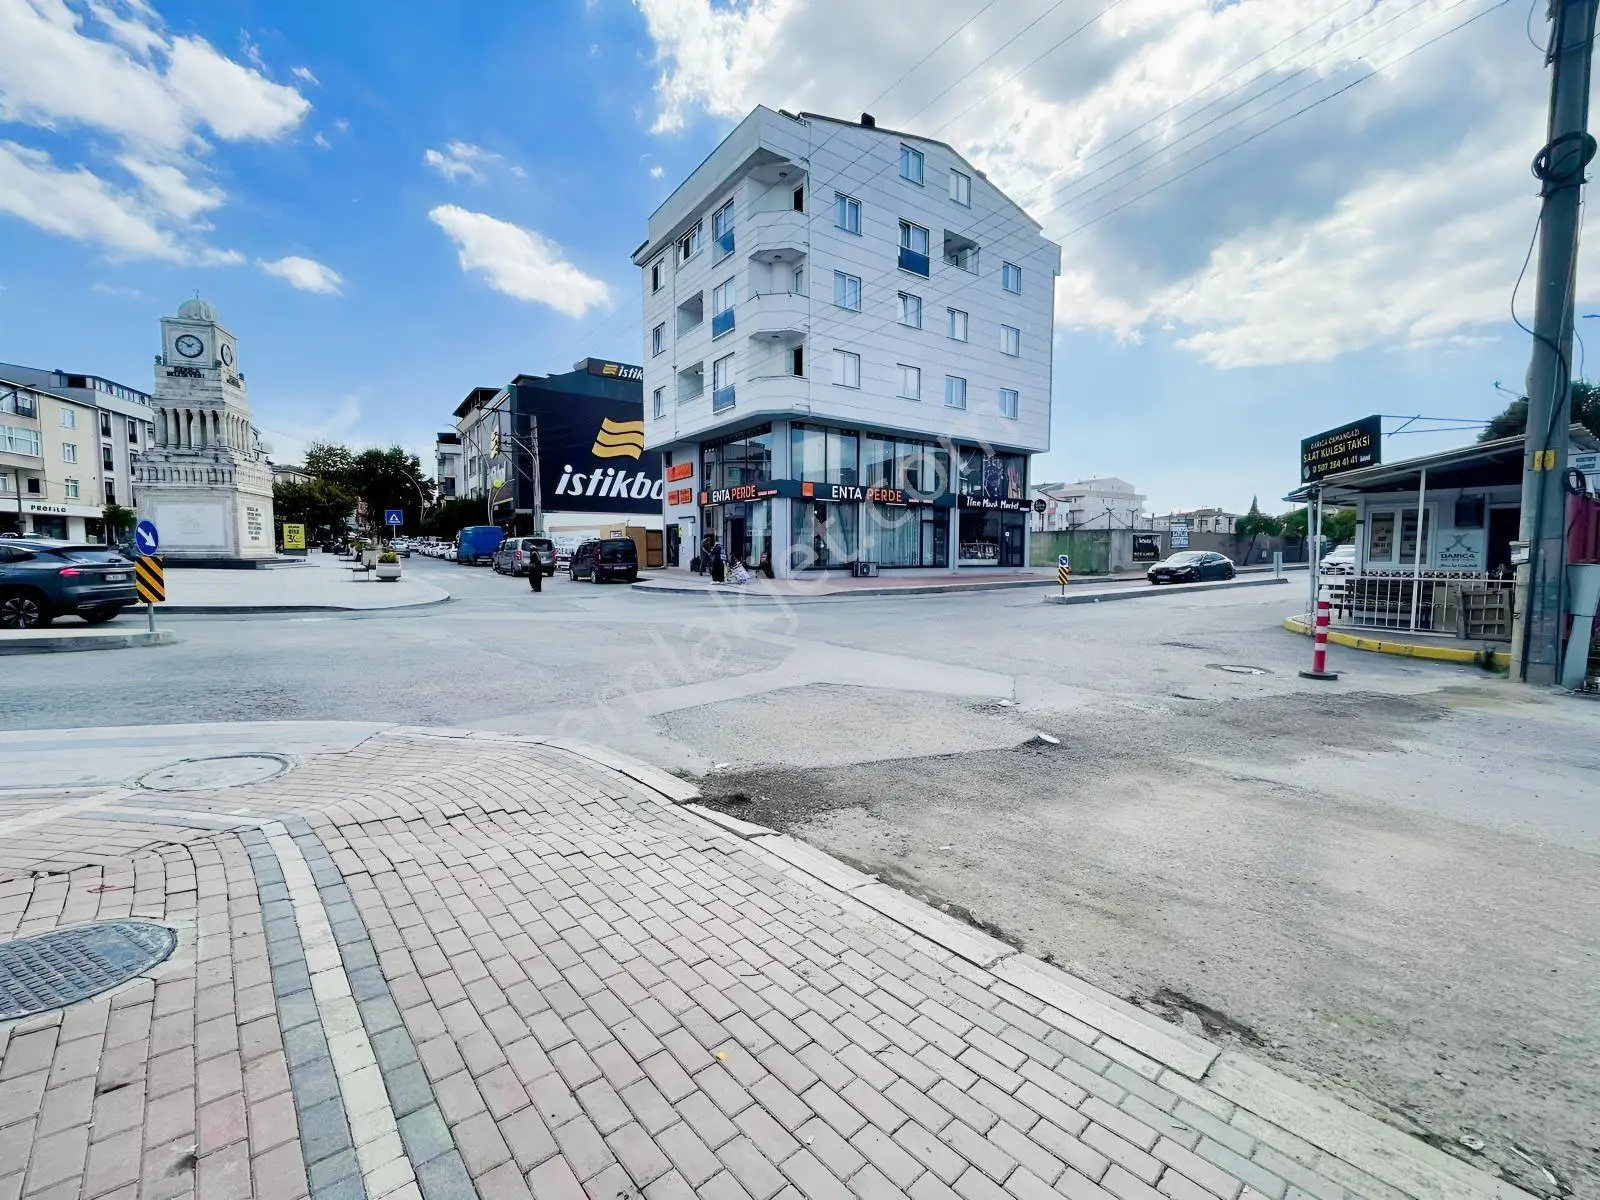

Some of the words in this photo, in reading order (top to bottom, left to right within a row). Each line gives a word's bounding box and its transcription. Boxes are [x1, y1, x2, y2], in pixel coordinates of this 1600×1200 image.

[1304, 450, 1319, 463] SAAT
[712, 489, 730, 503] ENTA
[731, 484, 756, 501] PERDE
[831, 485, 863, 500] ENTA
[866, 487, 902, 502] PERDE
